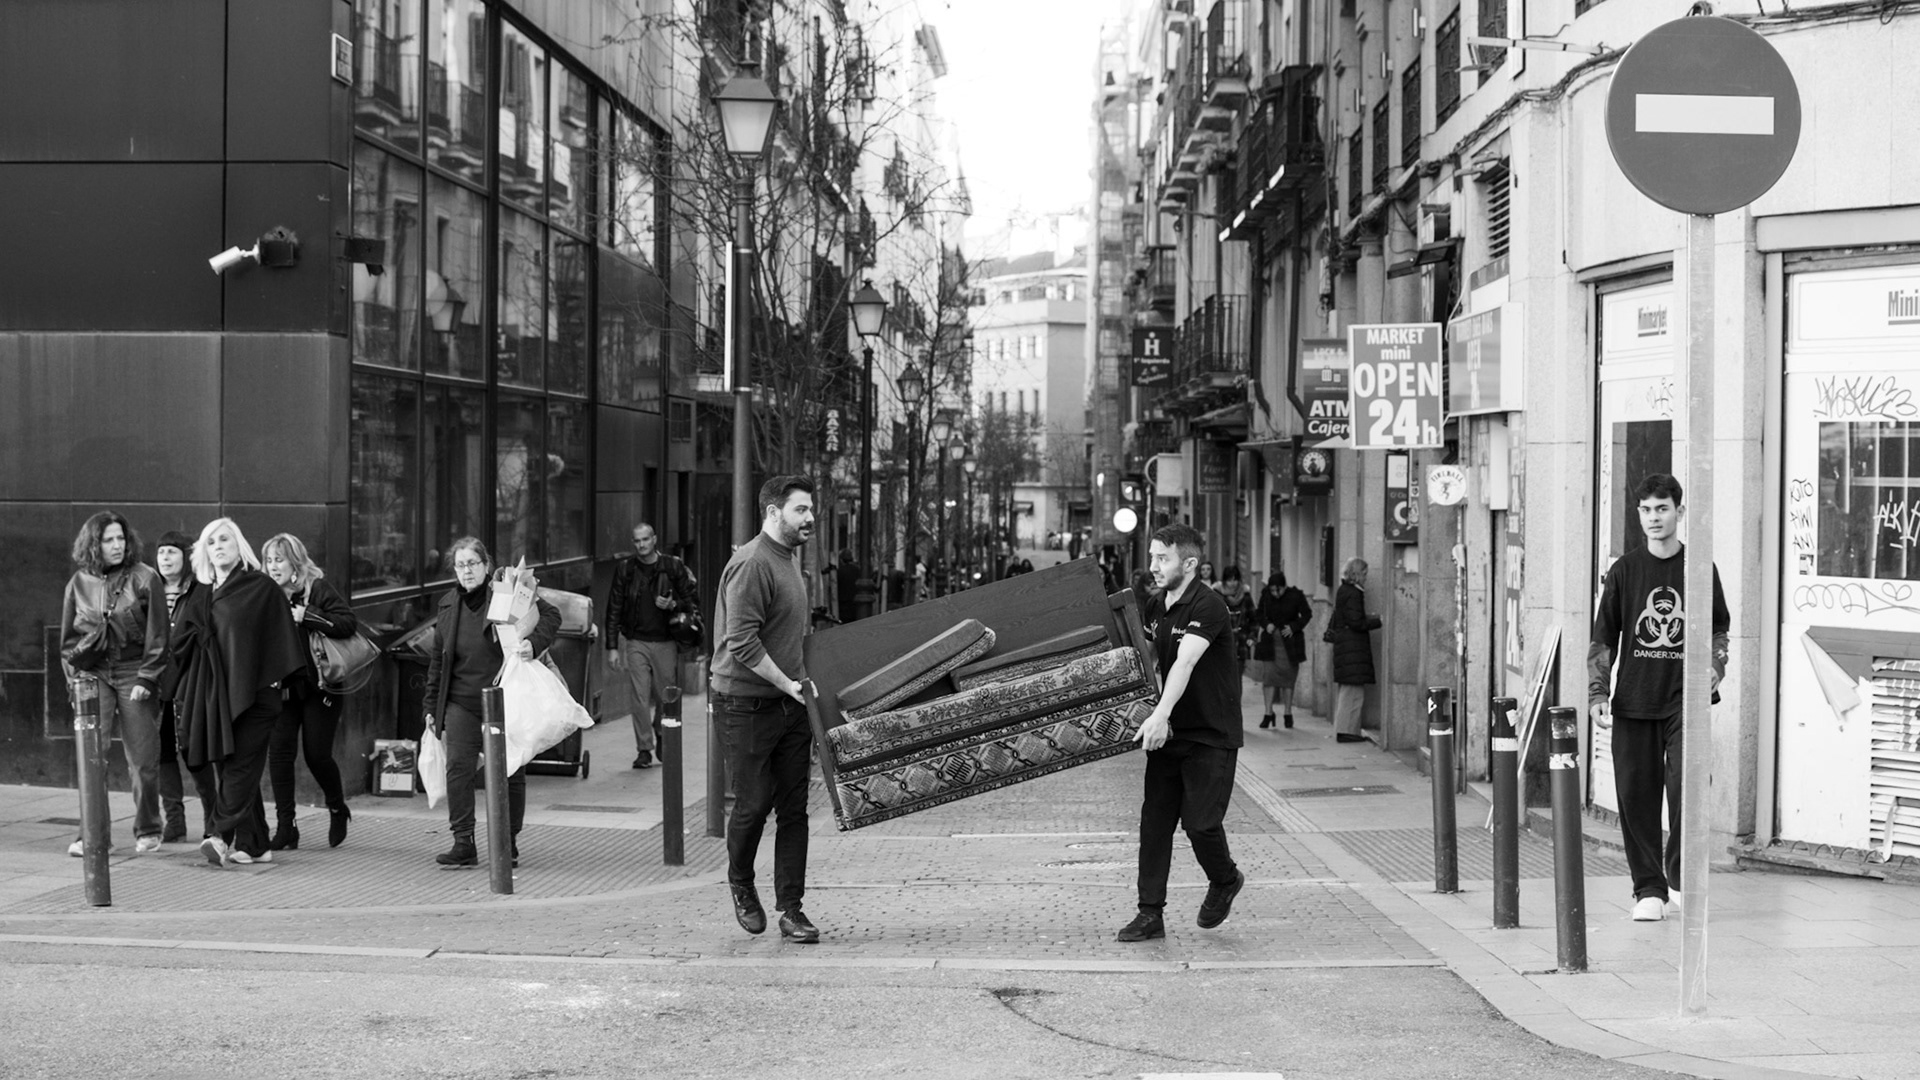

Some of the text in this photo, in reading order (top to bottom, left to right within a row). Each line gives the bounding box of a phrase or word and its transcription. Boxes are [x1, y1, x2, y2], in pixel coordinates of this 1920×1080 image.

[1888, 289, 1920, 317] Mini
[1366, 328, 1425, 345] MARKET
[1380, 345, 1411, 360] mini
[1354, 362, 1439, 398] OPEN
[1309, 400, 1350, 417] ATM
[1633, 649, 1685, 660] DANGERON
